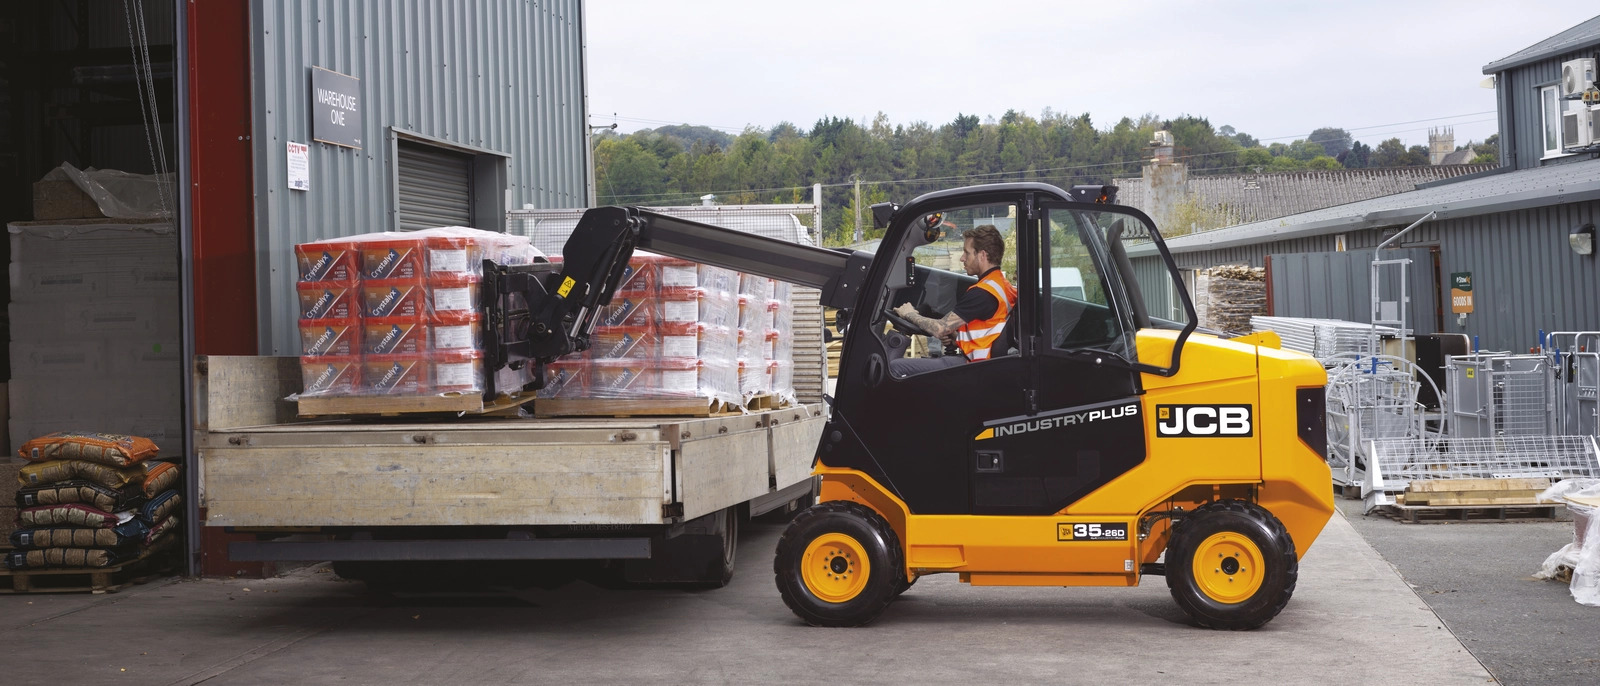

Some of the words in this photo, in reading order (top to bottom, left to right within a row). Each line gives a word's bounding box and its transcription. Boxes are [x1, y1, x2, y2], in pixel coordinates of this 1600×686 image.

[317, 88, 357, 111] WAREHOUSE
[330, 109, 346, 127] ONE
[288, 144, 300, 154] CCTV
[305, 255, 328, 280] Crystalyx
[371, 252, 395, 278] Crystalyx
[306, 292, 330, 318] Crystalyx
[372, 290, 396, 316] Crystalyx
[605, 301, 629, 325] Crystalyx
[1453, 296, 1467, 306] GOODS
[1467, 296, 1472, 306] IN
[308, 329, 331, 355] Crystalyx
[374, 328, 398, 353] Crystalyx
[309, 366, 333, 390] Crystalyx
[375, 364, 399, 390] Crystalyx
[995, 405, 1138, 437] INDUSTRYPLUS
[1159, 407, 1251, 435] JCB
